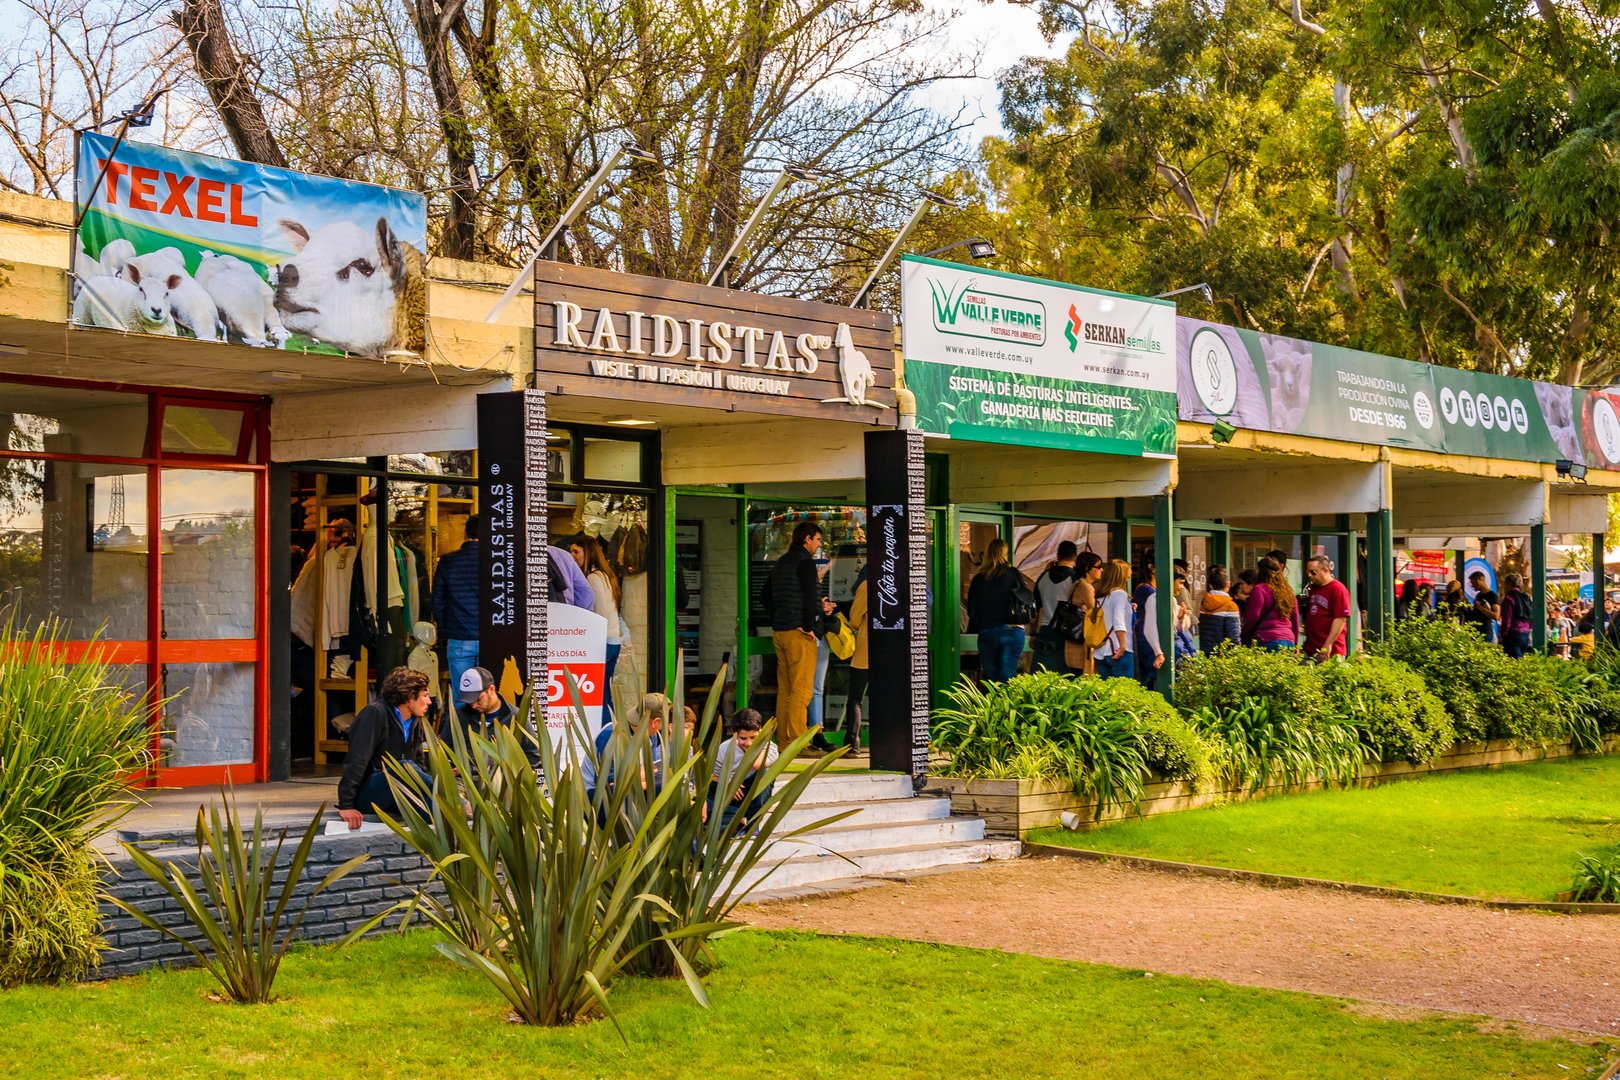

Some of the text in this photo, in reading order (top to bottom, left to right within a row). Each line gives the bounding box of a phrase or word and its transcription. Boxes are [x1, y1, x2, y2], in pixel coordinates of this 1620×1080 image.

[97, 158, 258, 227] TEXEL
[961, 302, 1041, 331] VALLE VERDE
[553, 300, 819, 374] RAIDISTAS
[1084, 322, 1126, 345] SERKAN
[945, 344, 1033, 365] www.valleverde.com.uy
[590, 359, 791, 395] VISTE TU PASIÓN URUGUAY
[1083, 363, 1150, 380] www.serkan.com.uy
[1336, 370, 1407, 395] TRABAJANDO EN LA
[949, 375, 1139, 411] SISTEMA DE PASTURAS INTELIGENTES...
[1338, 387, 1388, 407] PRODUCCIÓN
[1388, 396, 1411, 411] OVINA
[981, 400, 1041, 420] GANADERÍA
[1042, 403, 1063, 422] MÁS
[1349, 406, 1407, 430] DESDE 1966
[491, 483, 506, 625] RAIDISTAS
[505, 483, 515, 625] VISTE TU PASIÓN URUGUAY
[881, 558, 896, 573] tu
[877, 574, 899, 619] Viste
[570, 648, 587, 657] DÍAS
